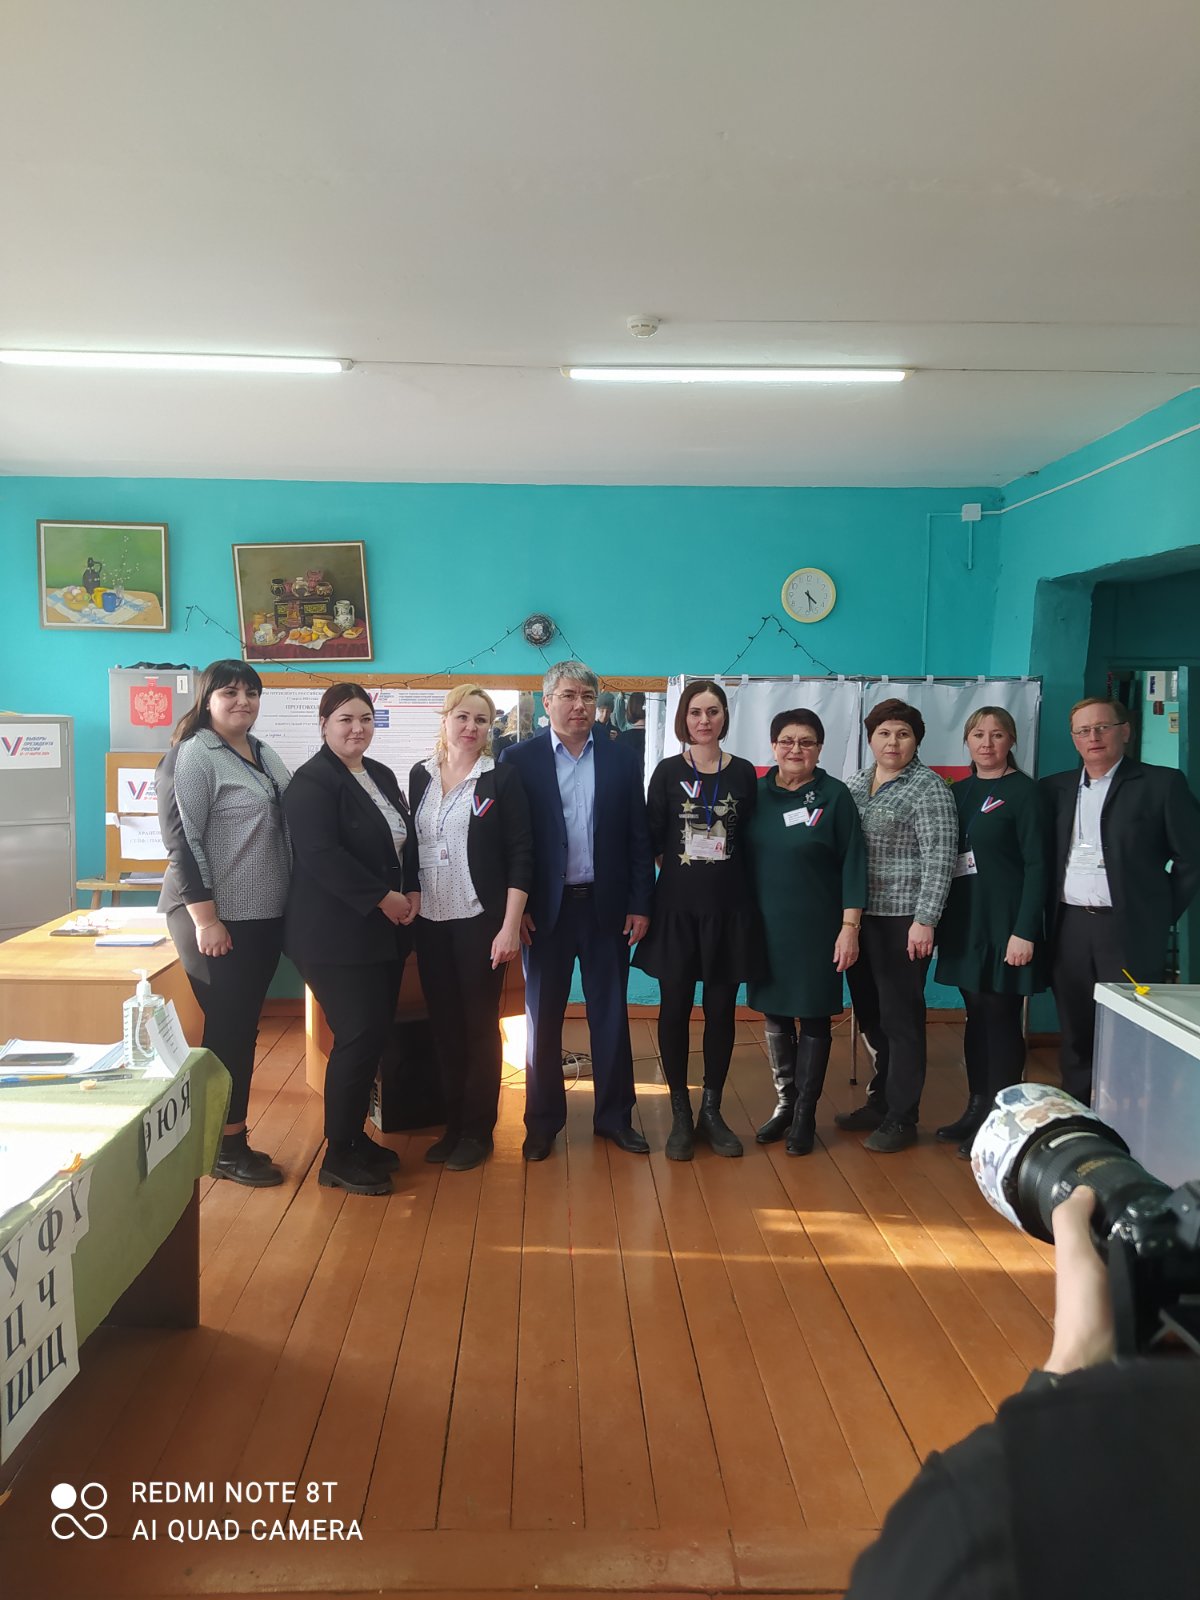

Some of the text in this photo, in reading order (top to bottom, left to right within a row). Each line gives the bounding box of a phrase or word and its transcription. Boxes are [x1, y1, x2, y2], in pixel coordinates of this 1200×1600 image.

[2, 1234, 23, 1299] У
[38, 1205, 63, 1257] Ф
[4, 1265, 57, 1361] Ц Ч
